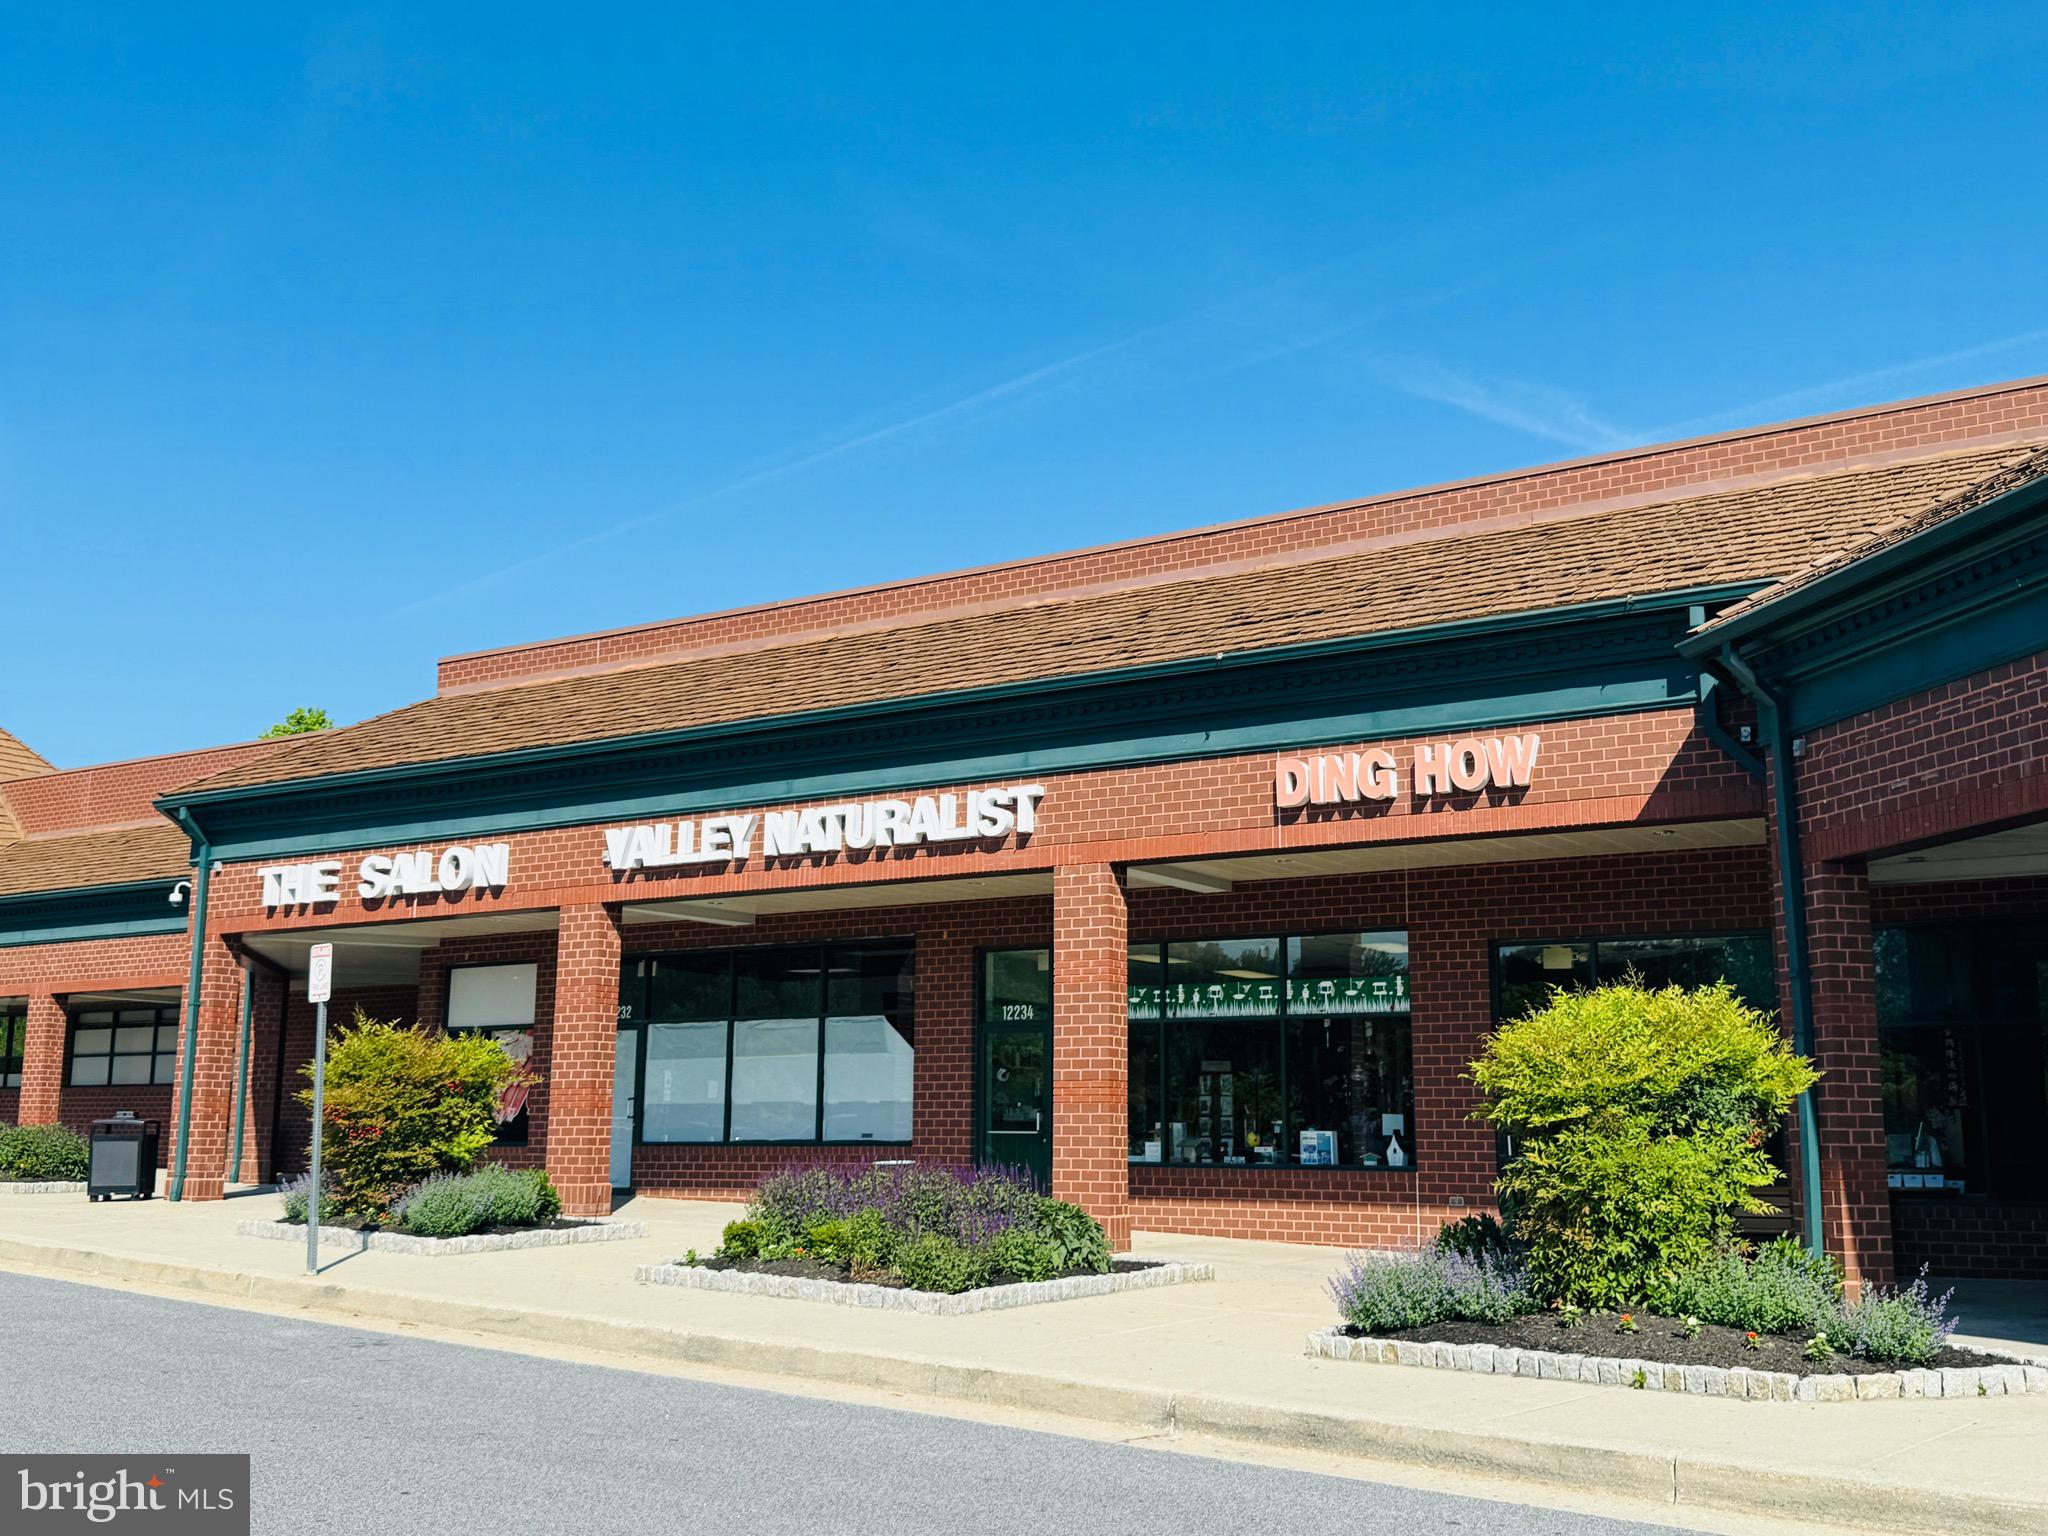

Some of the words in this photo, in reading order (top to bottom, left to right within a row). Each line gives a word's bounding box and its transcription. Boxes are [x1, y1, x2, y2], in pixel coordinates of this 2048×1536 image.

[1276, 749, 1397, 807] DING
[1414, 734, 1540, 795] HOW
[603, 814, 760, 869] VALLEY
[764, 784, 1045, 857] NATURALIST
[257, 861, 343, 906] THE
[357, 843, 510, 899] SALON
[1002, 1004, 1034, 1020] 12234
